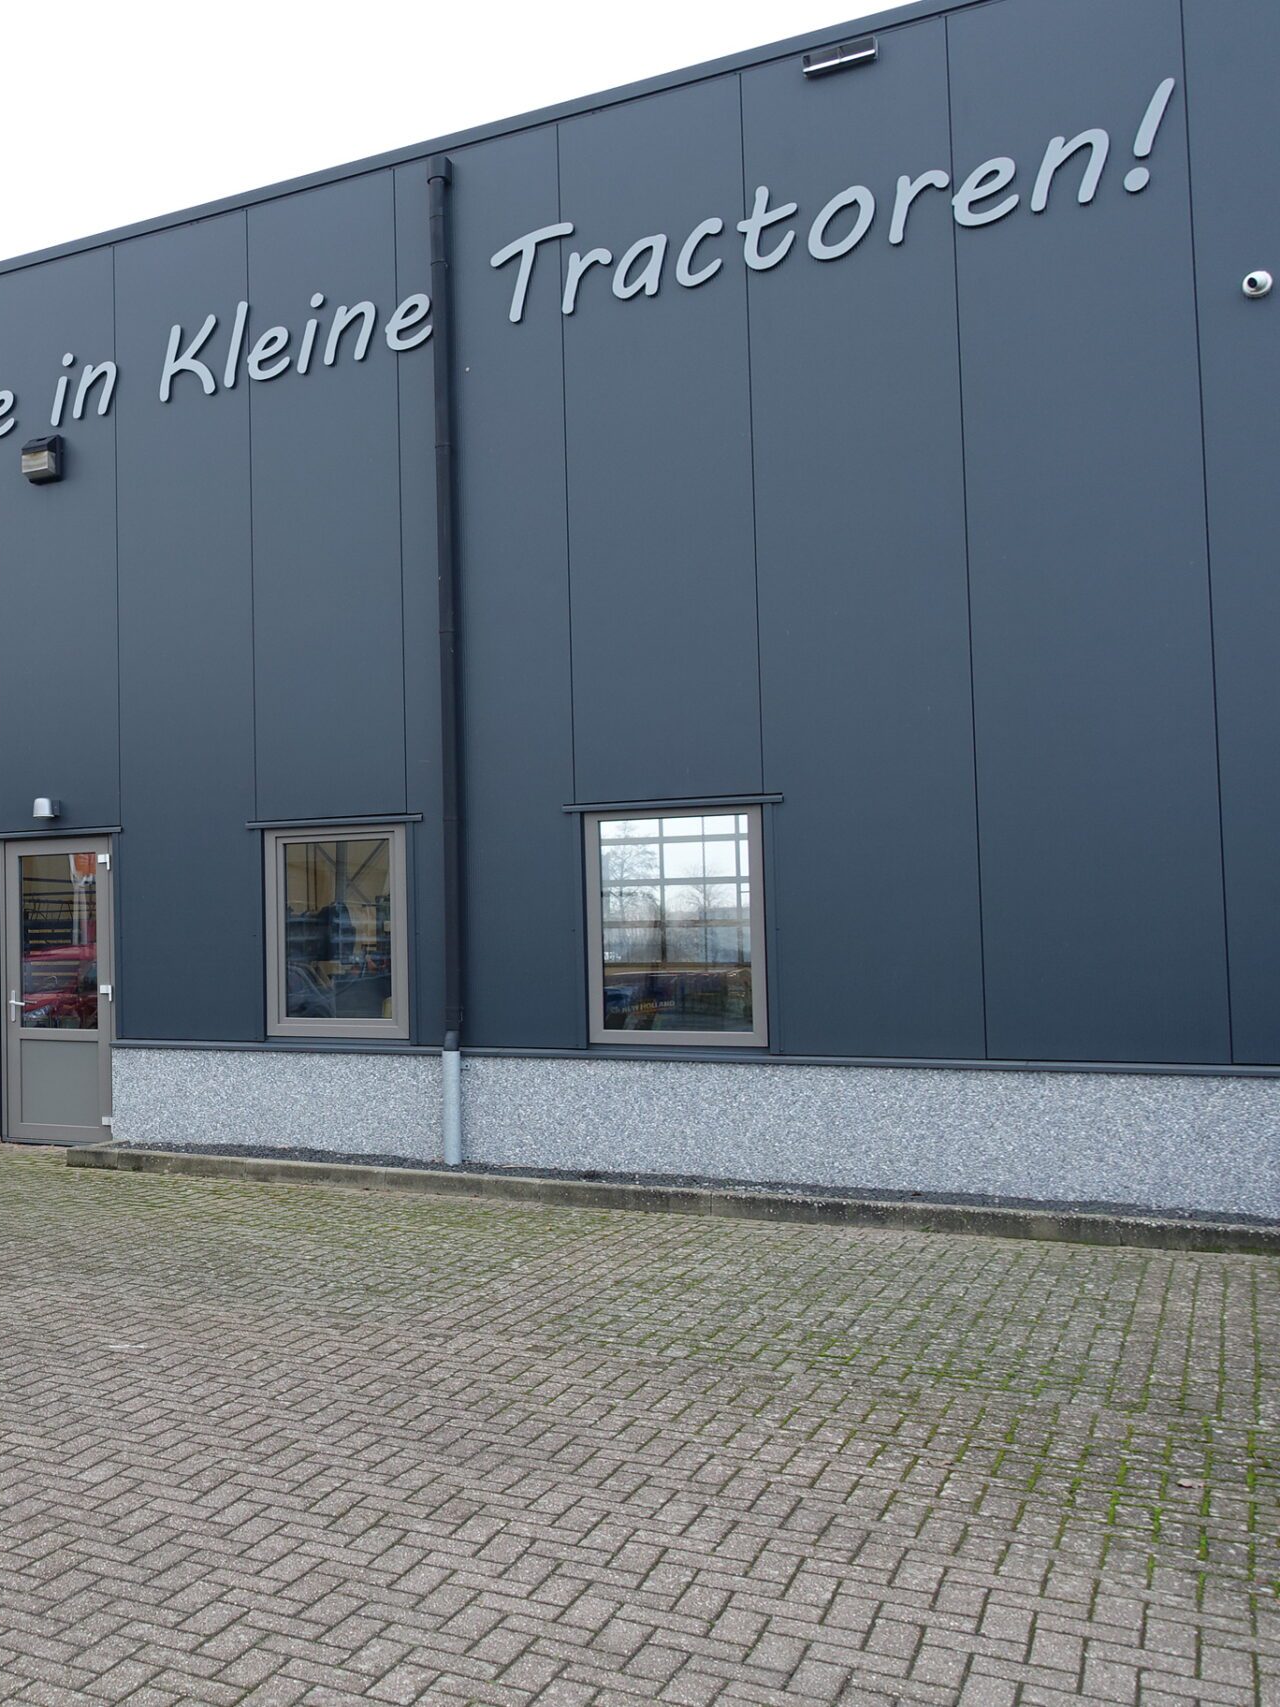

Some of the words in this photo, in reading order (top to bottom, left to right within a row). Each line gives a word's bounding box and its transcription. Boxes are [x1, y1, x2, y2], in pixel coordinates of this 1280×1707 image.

[50, 352, 117, 427] in
[159, 292, 433, 403] Kleine
[489, 77, 1175, 323] Tractoren!
